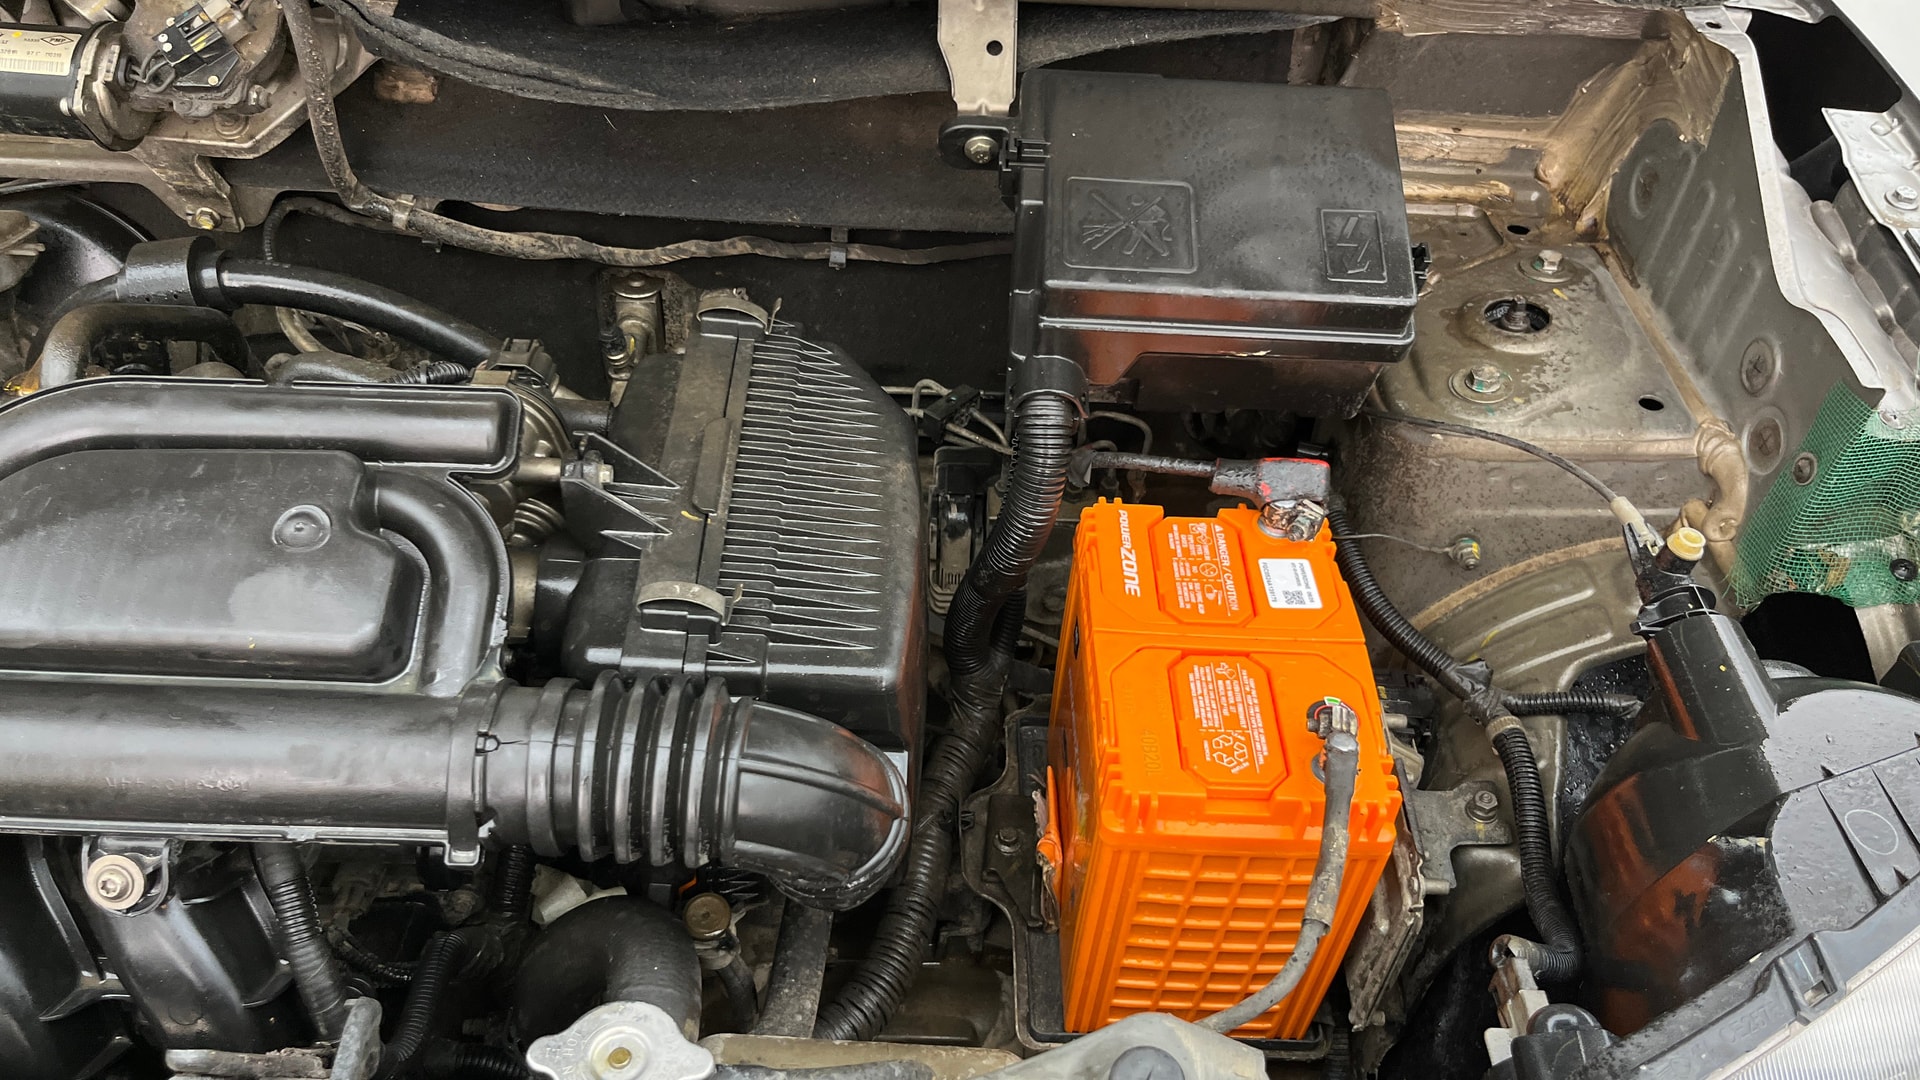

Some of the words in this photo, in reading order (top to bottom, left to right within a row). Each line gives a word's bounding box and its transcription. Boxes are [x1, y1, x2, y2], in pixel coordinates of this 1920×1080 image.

[1117, 509, 1141, 598] POWERZONE
[1215, 533, 1231, 567] DANGER
[1223, 573, 1240, 611] CAUTION
[1141, 729, 1161, 776] 40B20L
